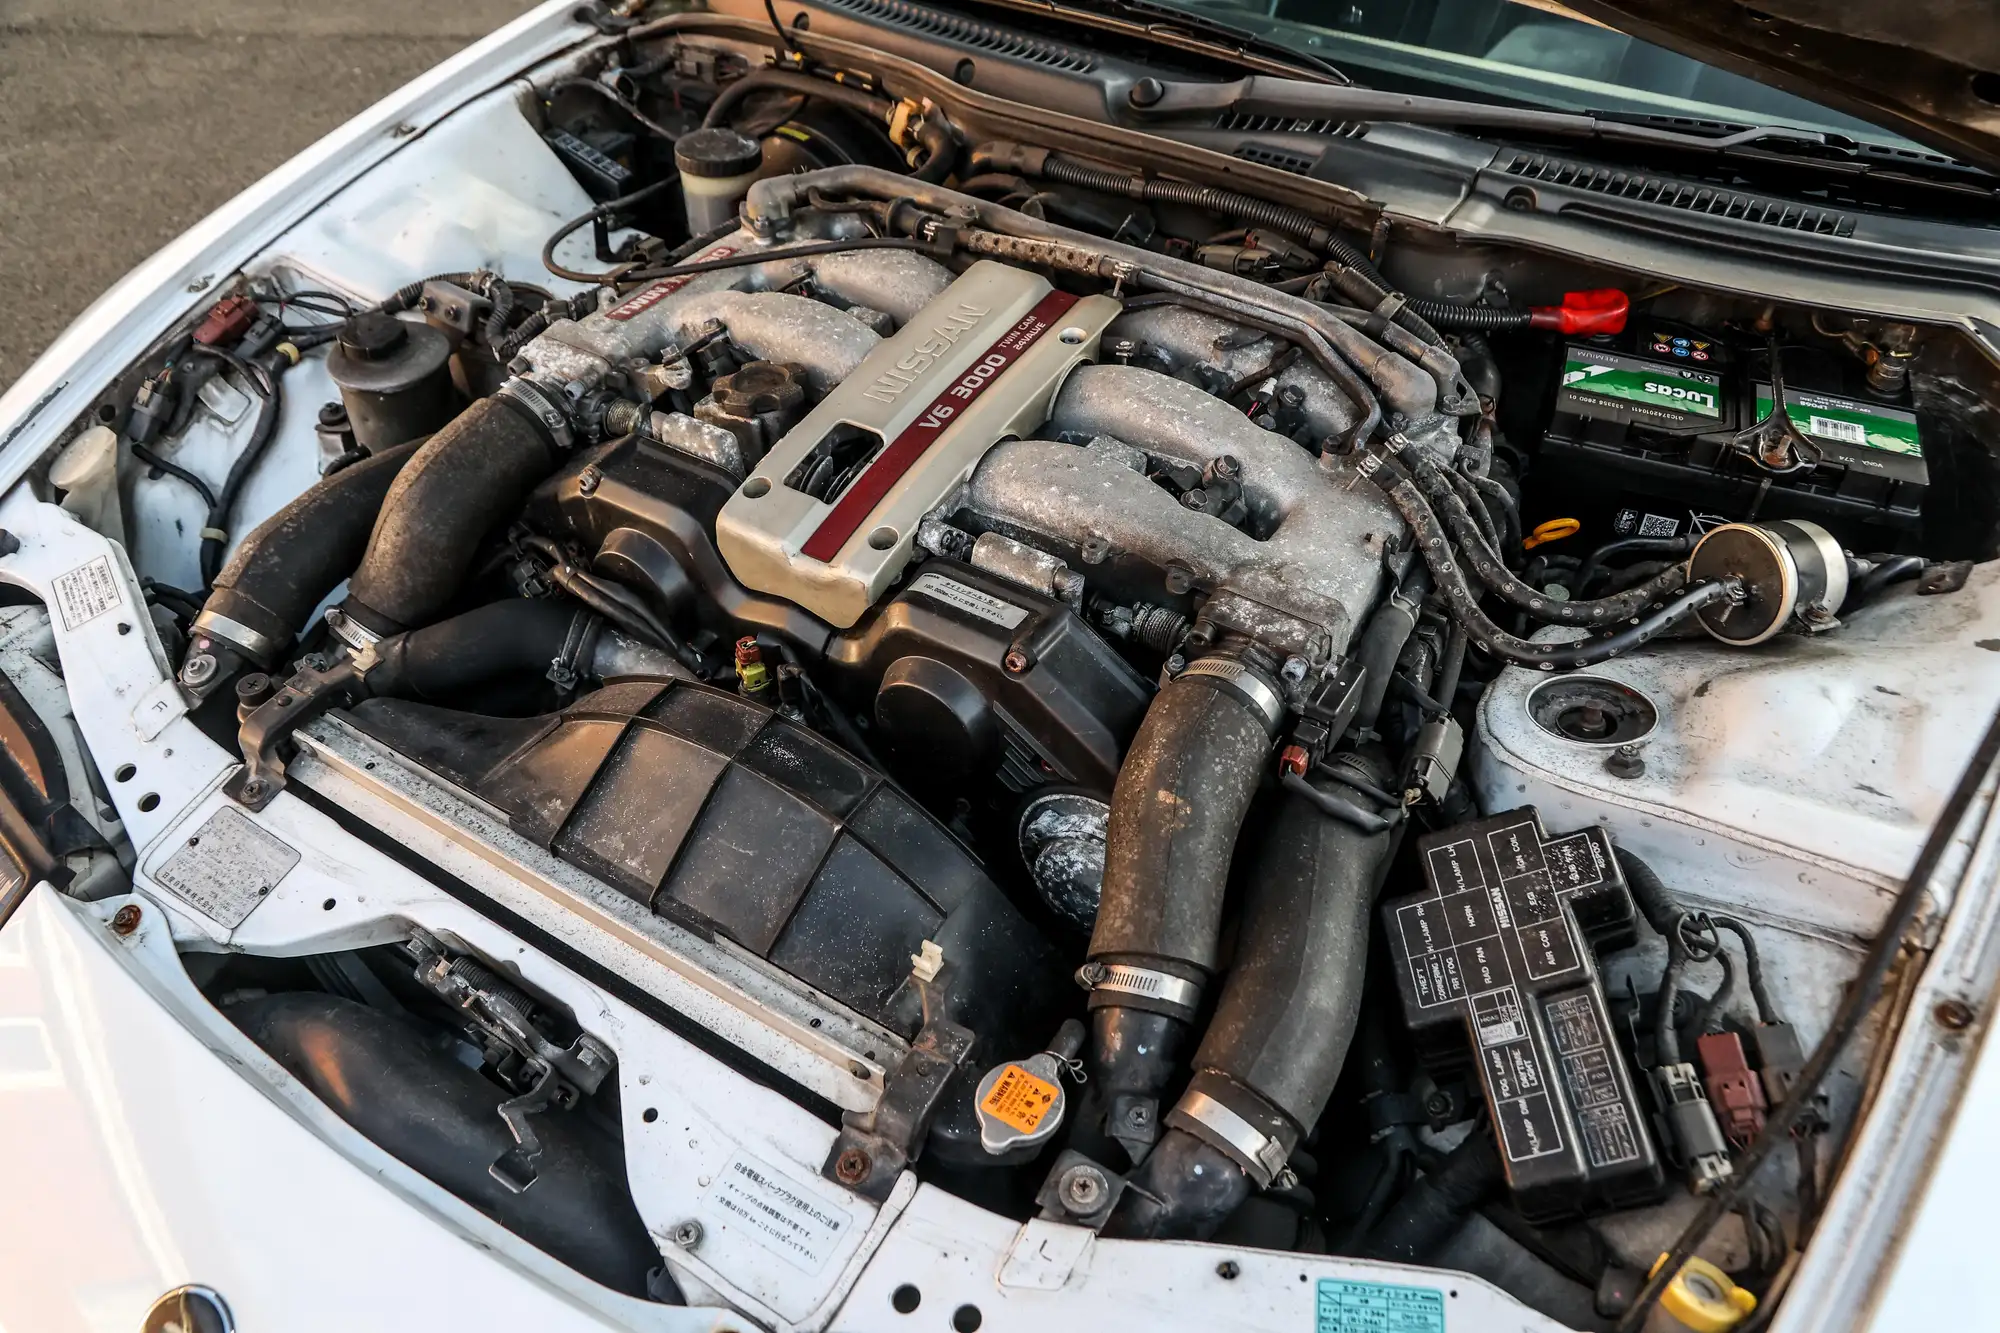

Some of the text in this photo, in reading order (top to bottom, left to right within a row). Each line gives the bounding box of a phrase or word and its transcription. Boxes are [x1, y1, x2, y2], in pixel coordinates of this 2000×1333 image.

[612, 285, 669, 315] TWIN
[998, 315, 1038, 348] TWIN CAM
[1013, 321, 1047, 350] 24VALVE
[863, 303, 991, 404] NISSAN
[1577, 351, 1619, 363] PREMIUM
[918, 354, 1007, 428] V6 3000
[1644, 382, 1714, 409] Lucas
[1509, 833, 1521, 853] COIL
[161, 871, 215, 913] 日産自動車株式会社
[1451, 860, 1466, 894] H/LAMP
[1490, 886, 1511, 929] NISSAN
[1526, 891, 1538, 906] EGI
[1416, 903, 1436, 953] H/LAMP RH
[1464, 904, 1476, 928] HORN
[1539, 929, 1556, 966] AIR CON
[1416, 967, 1429, 996] THEFT
[1446, 956, 1461, 991] RR FOG
[1475, 946, 1493, 985] RAD FAN
[1491, 1049, 1511, 1098] FOG LAMP
[1523, 1059, 1538, 1087] LIGHT
[989, 1080, 1012, 1106] WARNING
